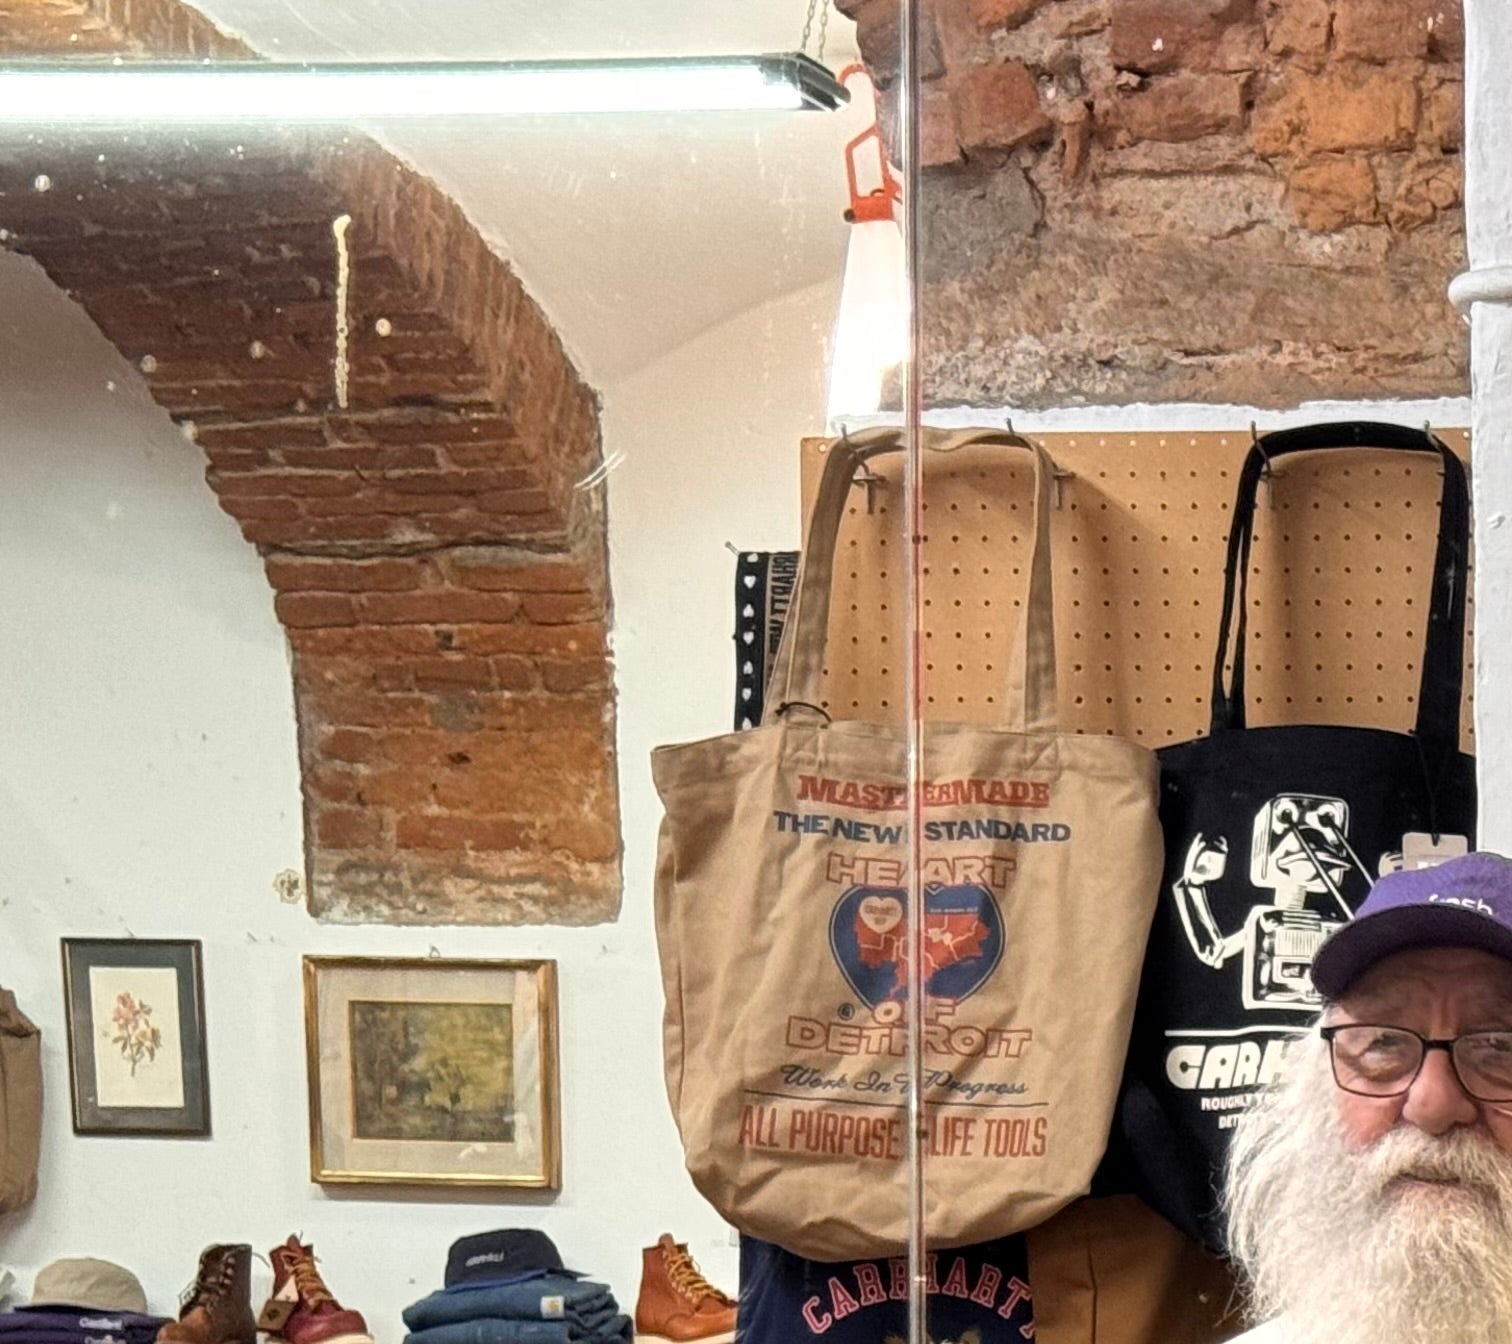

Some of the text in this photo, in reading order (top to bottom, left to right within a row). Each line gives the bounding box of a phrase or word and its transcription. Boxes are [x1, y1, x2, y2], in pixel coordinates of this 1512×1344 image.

[796, 774, 1050, 808] MASTERMADE
[773, 811, 1072, 844] THE NEW STANDARD
[826, 852, 1018, 889] HEART
[872, 997, 956, 1027] OF
[785, 1015, 1032, 1059] DETROIT
[780, 1064, 1029, 1100] Work In Progress
[738, 1105, 1049, 1162] ALL PURPOSE LIFE TOOLS
